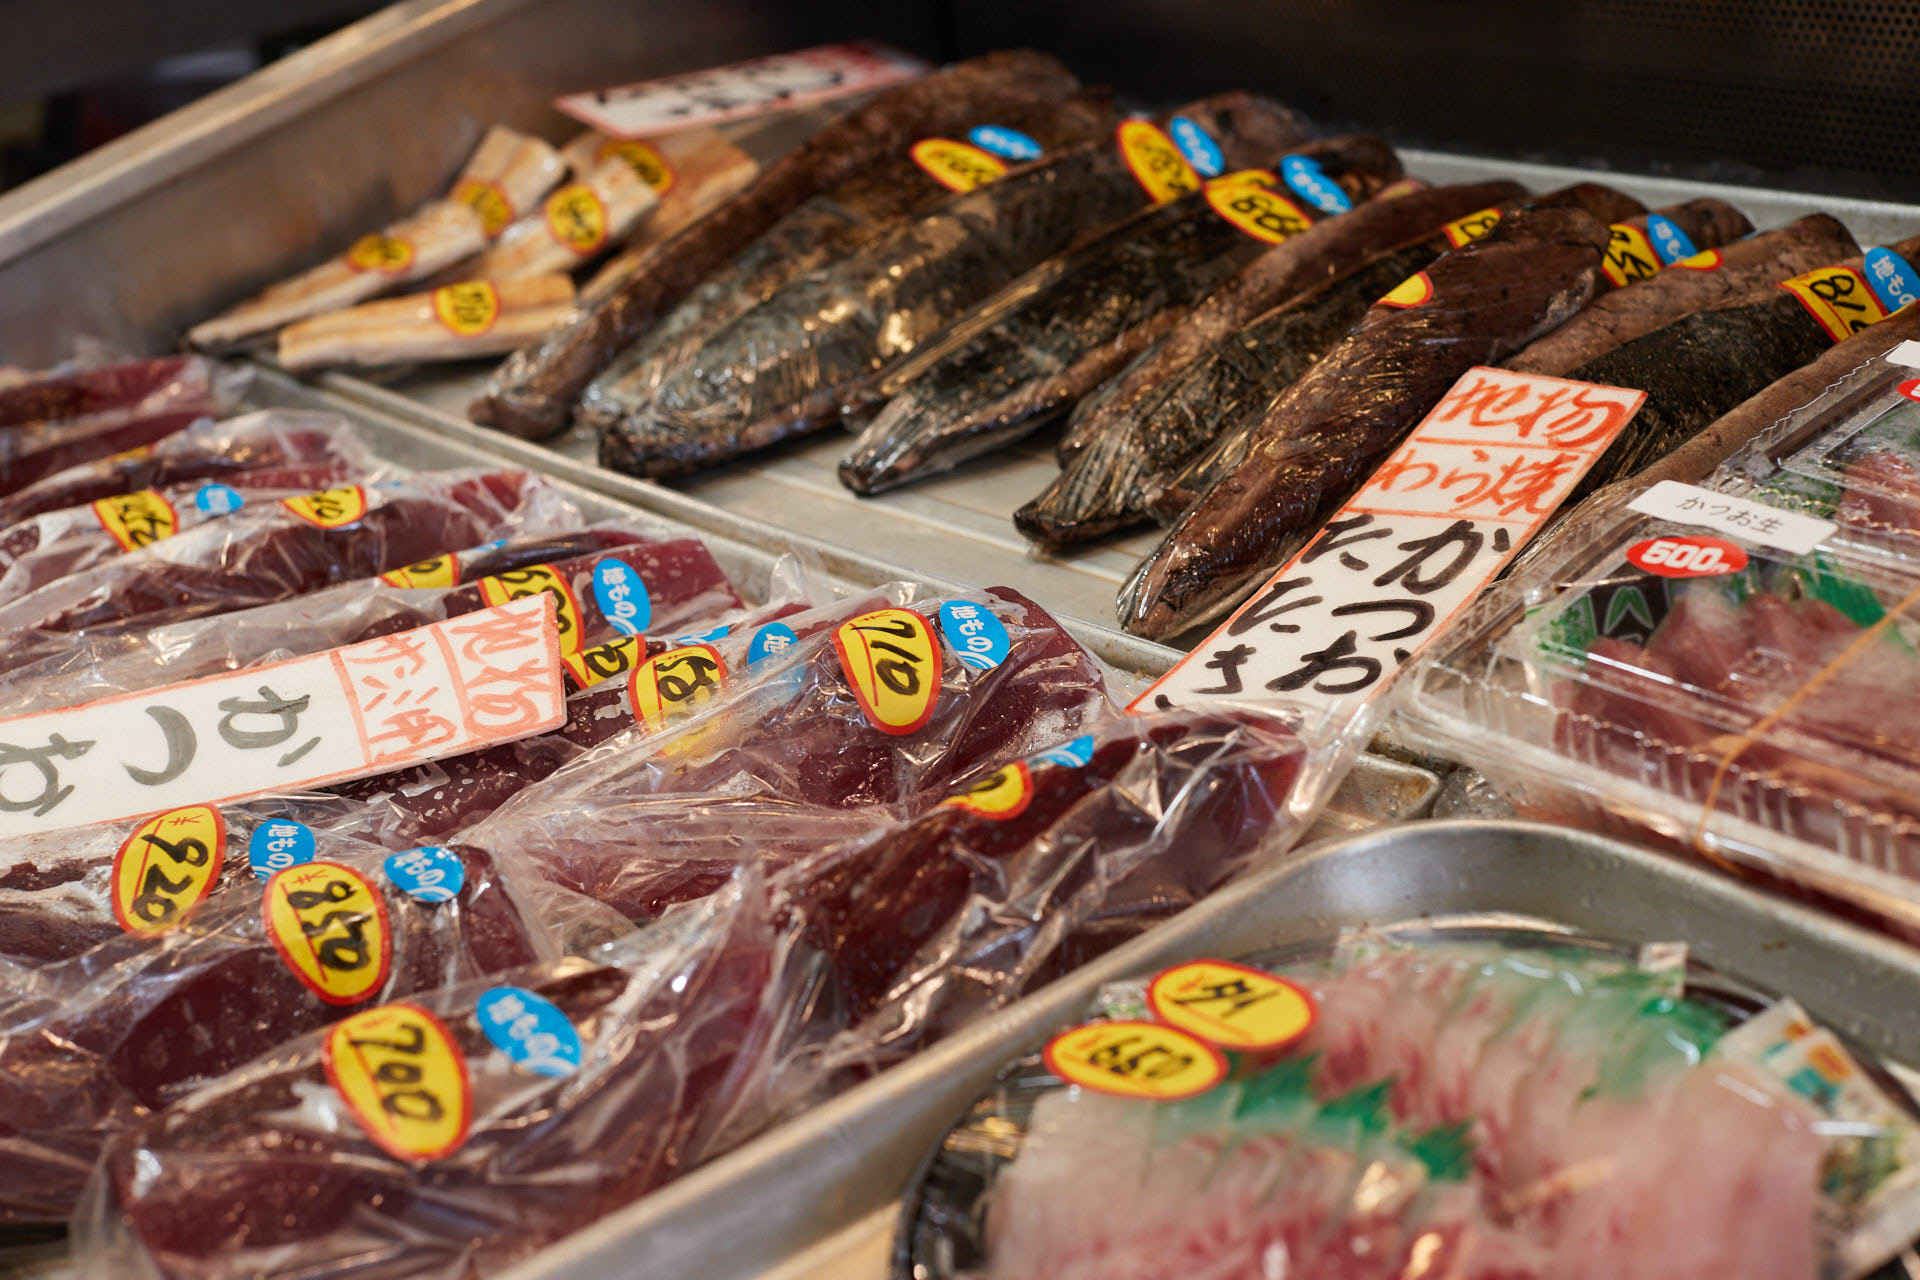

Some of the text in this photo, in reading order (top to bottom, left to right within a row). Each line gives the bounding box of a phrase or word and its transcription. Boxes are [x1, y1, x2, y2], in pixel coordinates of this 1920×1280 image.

[1440, 377, 1627, 448] 地物
[1371, 449, 1581, 515] わら焼
[1676, 496, 1784, 535] かつお生
[601, 566, 637, 620] 地もの
[951, 604, 993, 656] 地もの
[0, 685, 323, 817] かつお
[266, 823, 297, 869] 地もの
